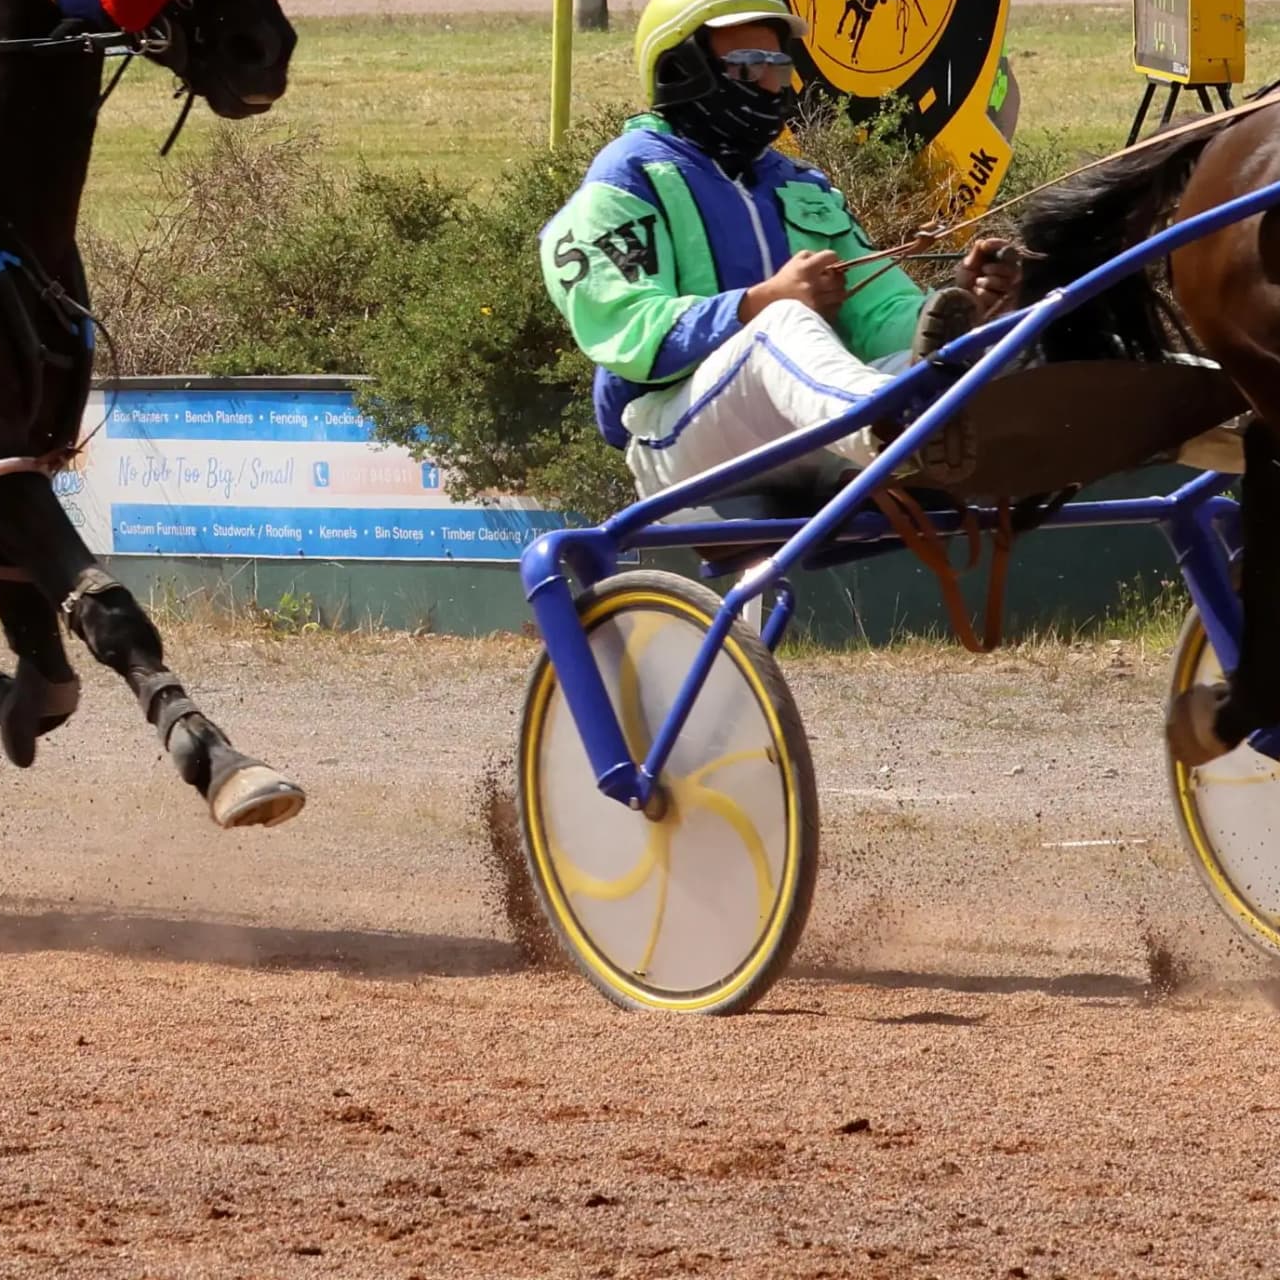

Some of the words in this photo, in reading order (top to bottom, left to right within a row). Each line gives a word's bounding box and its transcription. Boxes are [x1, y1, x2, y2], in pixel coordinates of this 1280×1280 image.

[113, 409, 130, 423] Box
[132, 410, 169, 424] Planters
[185, 410, 214, 424] Bench
[215, 410, 254, 425] Planters
[270, 411, 308, 428] Fencing
[325, 412, 364, 428] Decking
[118, 455, 138, 487] No
[142, 455, 171, 488] Job
[175, 456, 200, 489] Too
[250, 457, 294, 490] Small
[120, 521, 155, 536] Custom
[156, 522, 197, 537] Furniture
[212, 523, 255, 537] Studwork
[266, 524, 302, 541] Roofing
[320, 525, 357, 539] Kennels
[375, 526, 390, 539] Bin
[393, 526, 424, 540] Stores
[440, 527, 475, 541] Timber
[478, 527, 521, 544] Cladding
